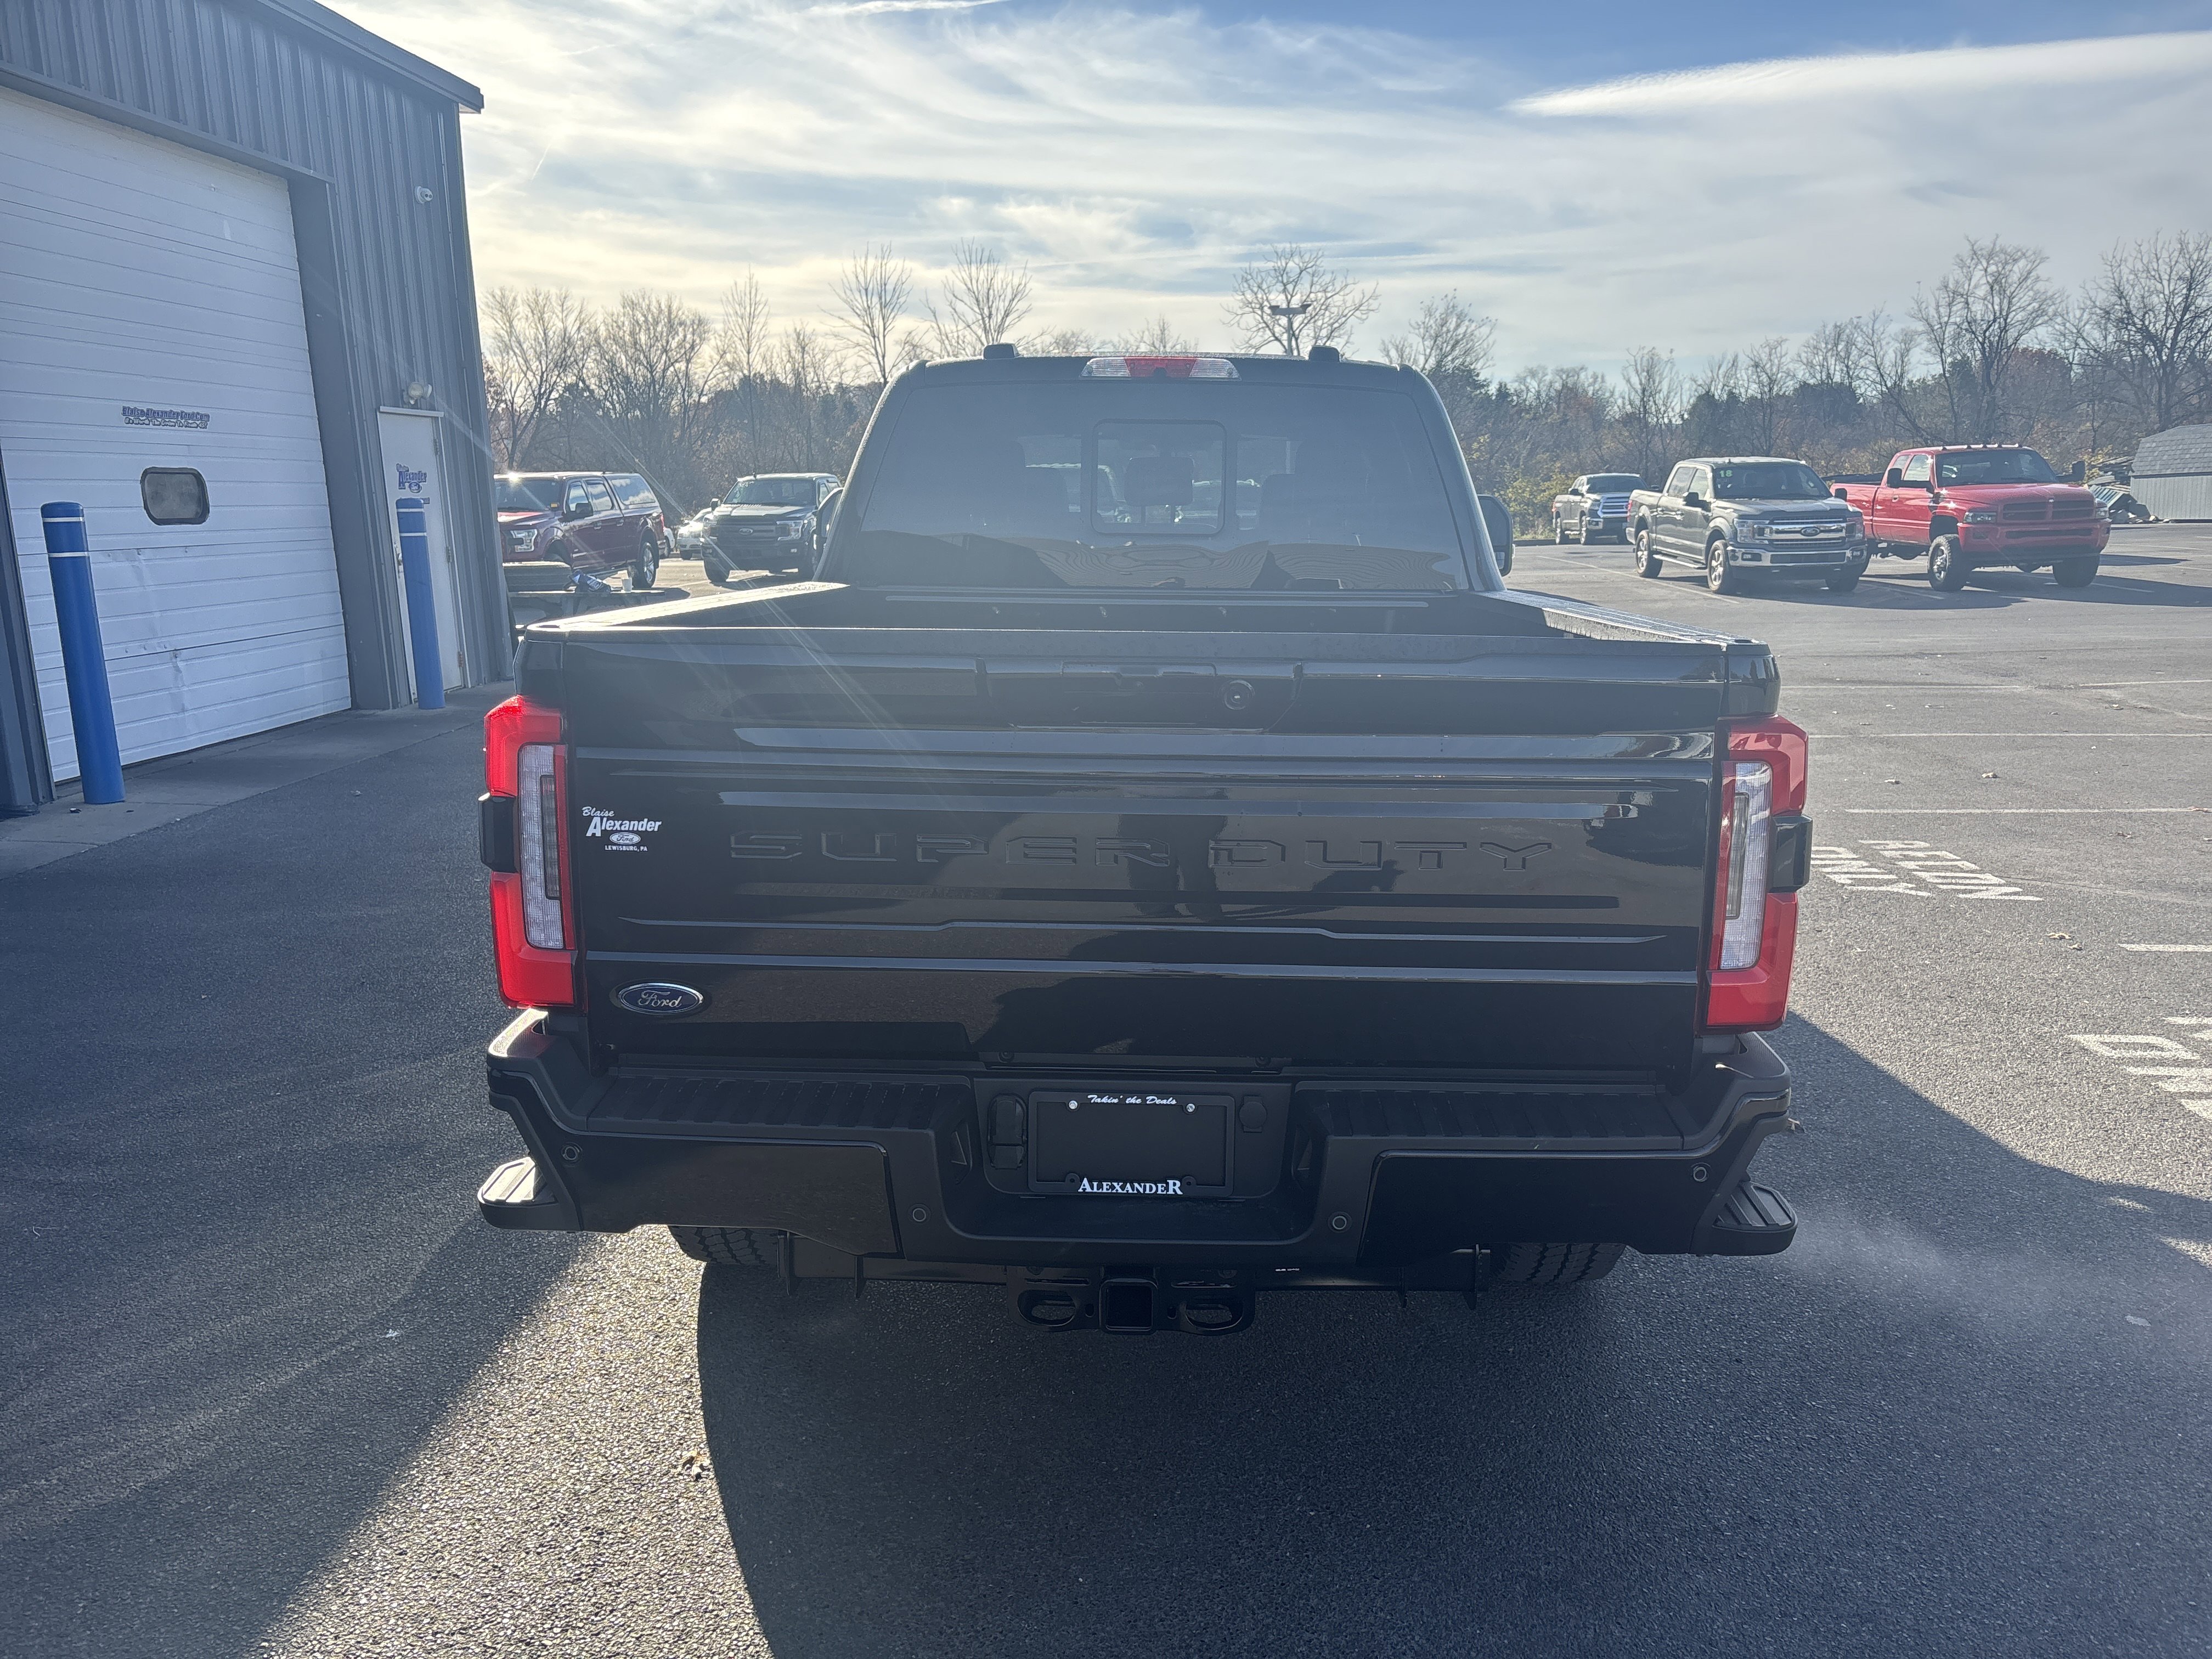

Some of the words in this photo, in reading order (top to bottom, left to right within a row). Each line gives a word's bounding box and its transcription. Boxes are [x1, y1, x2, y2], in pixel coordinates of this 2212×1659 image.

[398, 471, 427, 490] Alexander
[582, 806, 615, 817] Blaise
[585, 817, 662, 837] Alexander
[616, 834, 634, 843] Ford
[730, 832, 1170, 867] SUPER
[1208, 838, 1553, 871] DUTY
[638, 990, 682, 1008] Ford
[1087, 1094, 1123, 1104] Takin'
[1126, 1096, 1142, 1104] the
[1146, 1096, 1177, 1105] Deals
[1077, 1177, 1183, 1195] ALEXANDER
